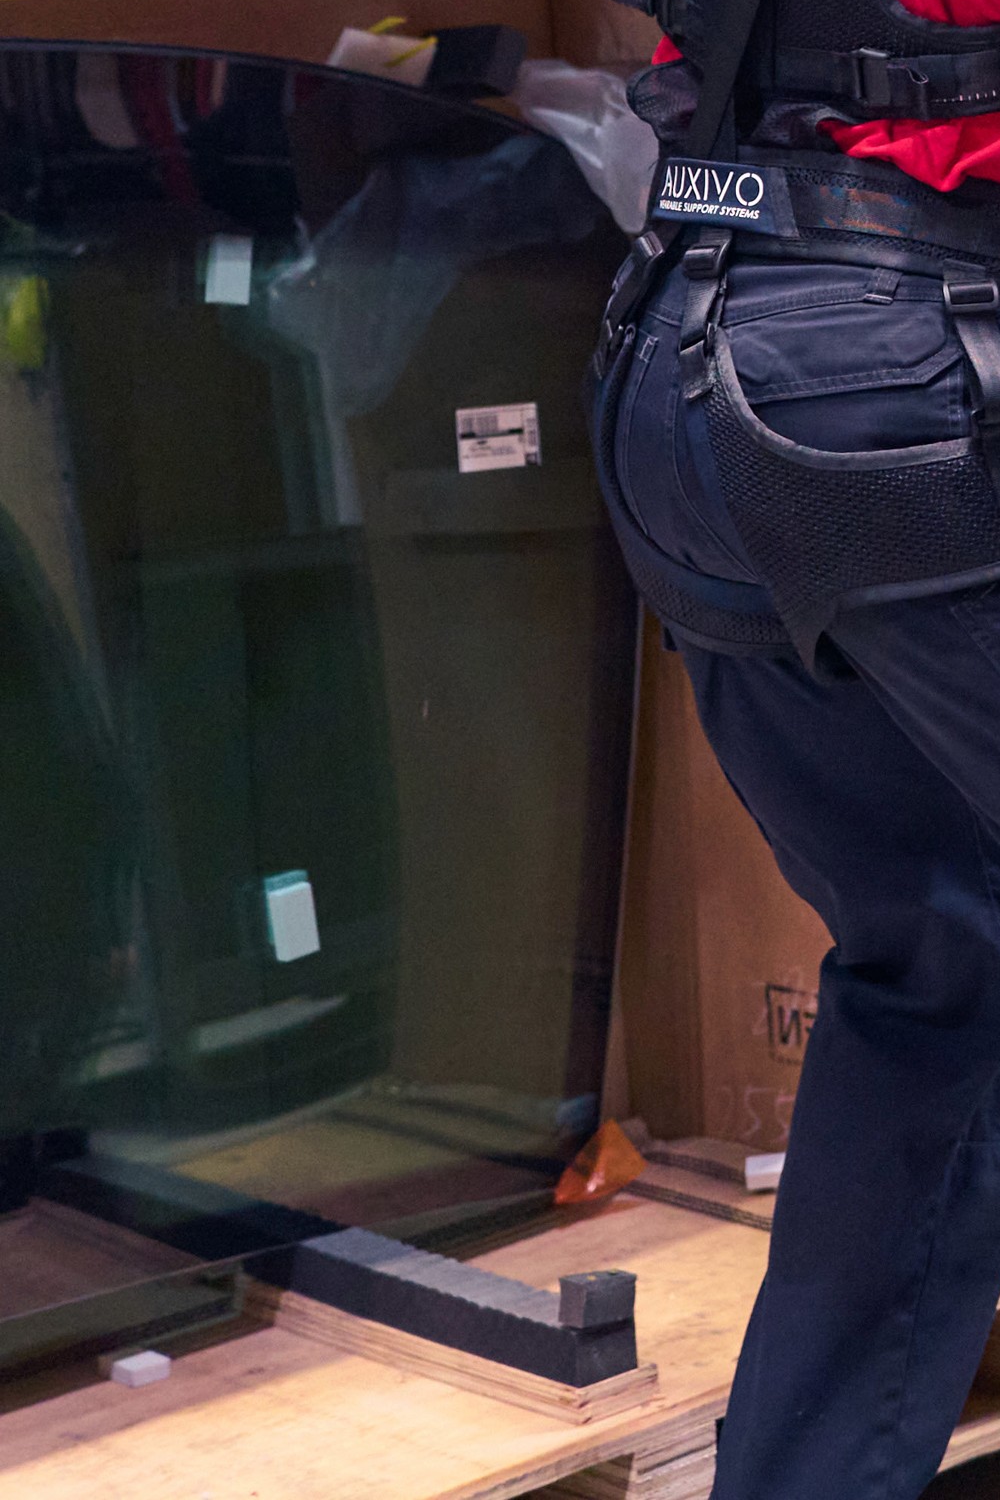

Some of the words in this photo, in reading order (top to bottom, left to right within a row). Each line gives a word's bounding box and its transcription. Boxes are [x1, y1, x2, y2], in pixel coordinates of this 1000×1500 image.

[661, 165, 764, 207] AUXIVO
[683, 202, 719, 215] SUPPORT
[719, 206, 760, 219] SYSTEMS
